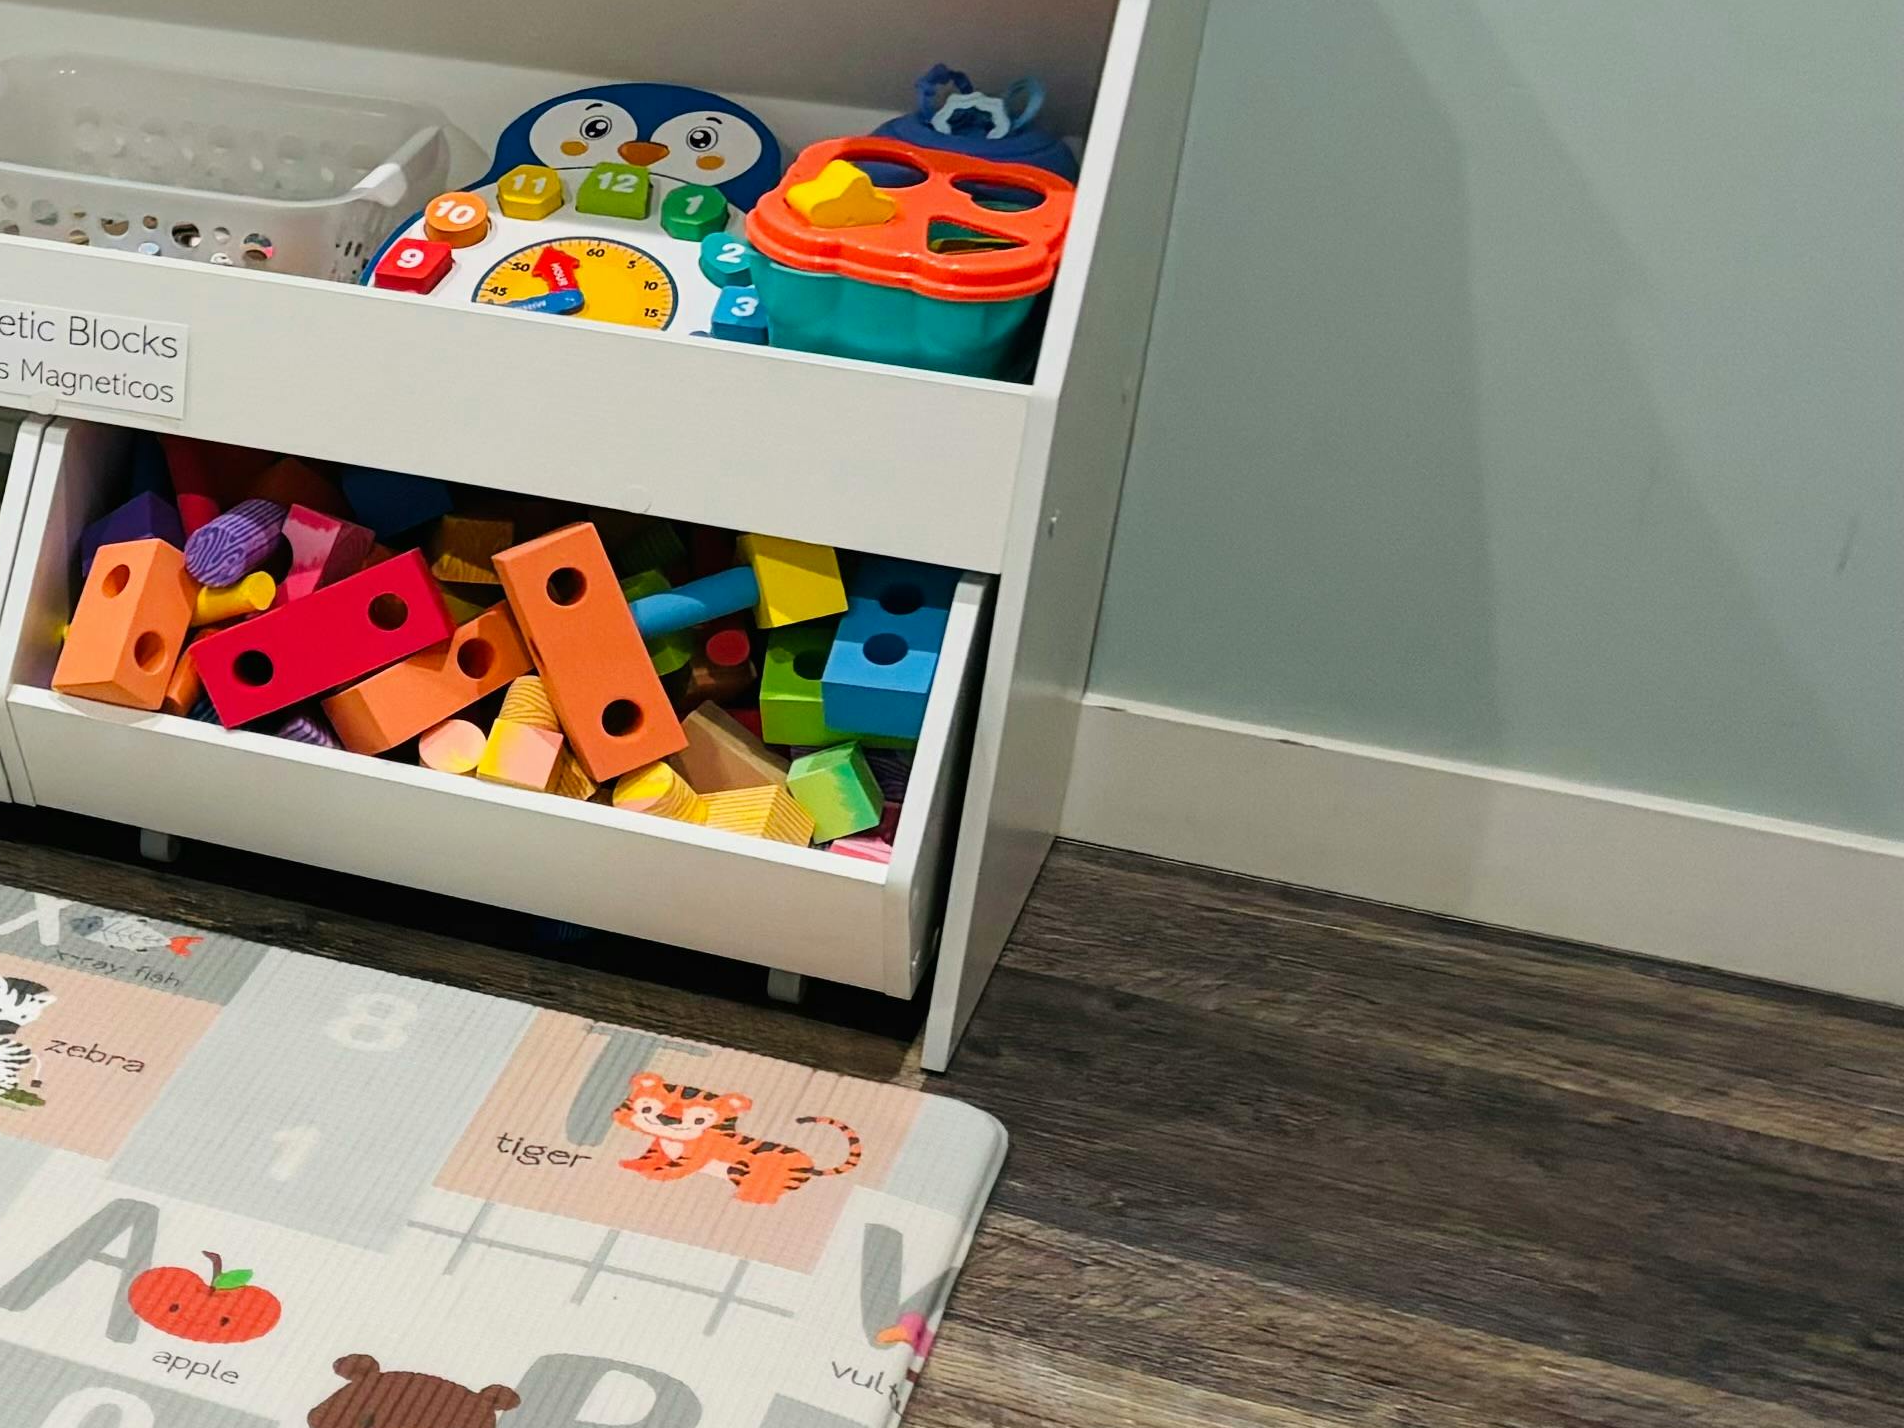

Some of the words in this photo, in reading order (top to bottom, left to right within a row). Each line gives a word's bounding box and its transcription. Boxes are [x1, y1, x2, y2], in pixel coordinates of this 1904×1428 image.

[512, 173, 547, 194] 11
[596, 170, 639, 194] 12
[435, 201, 477, 223] 10
[686, 194, 705, 214] 1
[396, 248, 425, 269] 9
[716, 242, 746, 264] 2
[511, 262, 530, 272] 50
[627, 260, 637, 270] 5
[490, 286, 507, 296] 45
[644, 280, 658, 291] 10
[644, 308, 659, 318] 15
[730, 295, 759, 317] 3
[69, 315, 178, 359] Blocks
[21, 358, 175, 403] Magneticos
[323, 991, 418, 1052] 8
[45, 1035, 147, 1076] zebra
[564, 1021, 714, 1147] T
[495, 1129, 593, 1171] tiger
[150, 1345, 241, 1387] apple
